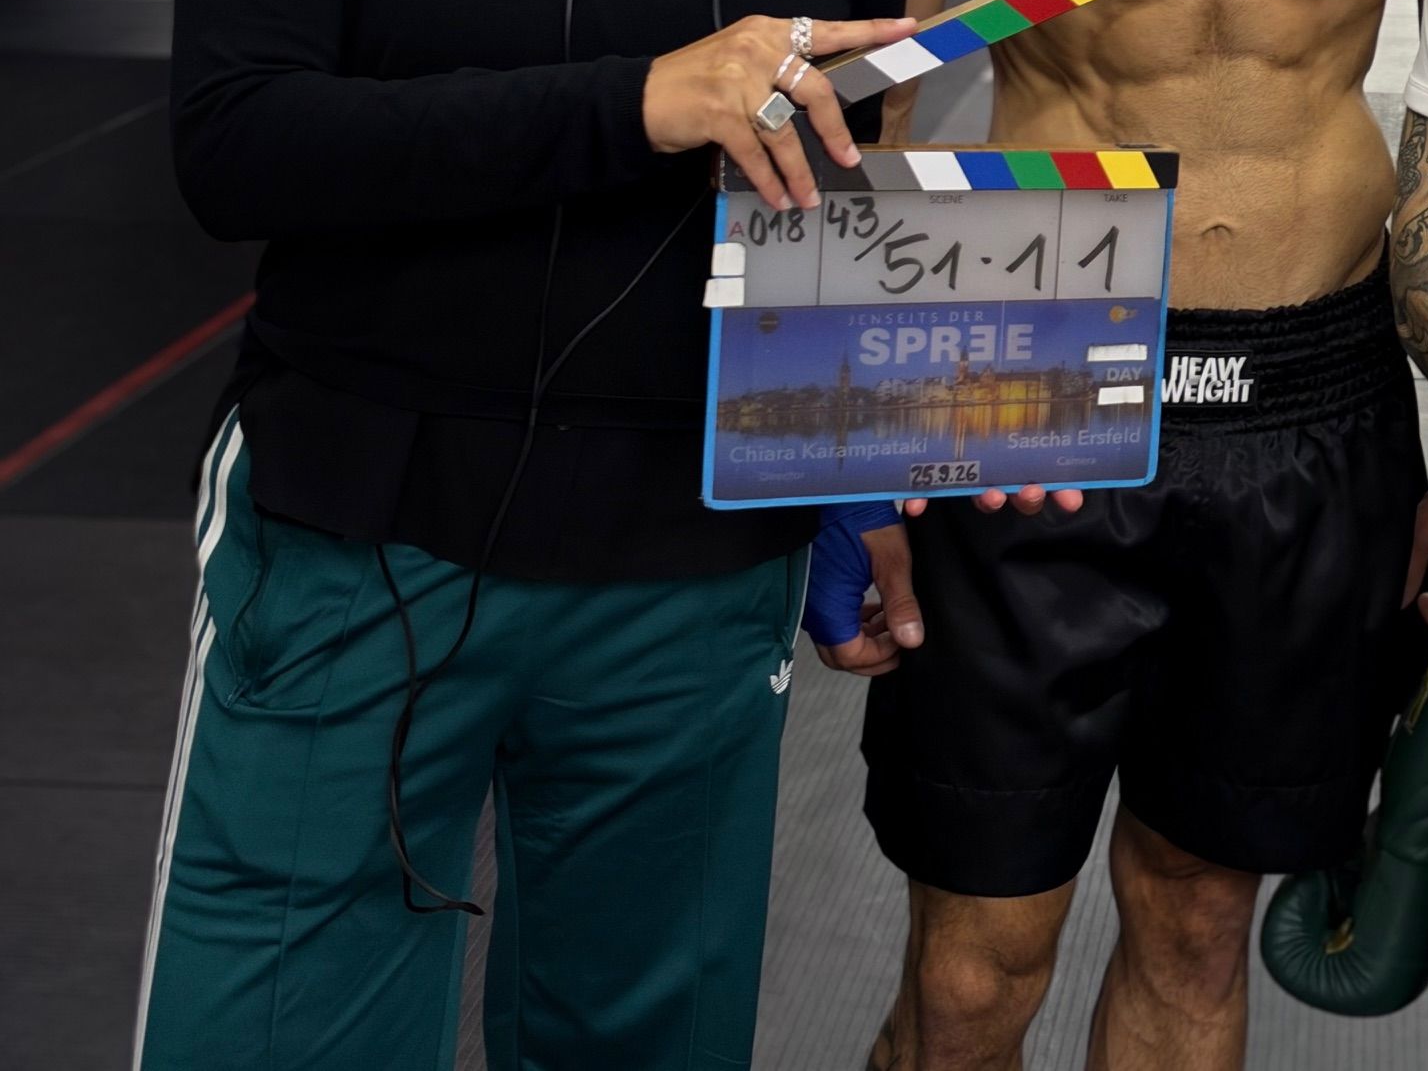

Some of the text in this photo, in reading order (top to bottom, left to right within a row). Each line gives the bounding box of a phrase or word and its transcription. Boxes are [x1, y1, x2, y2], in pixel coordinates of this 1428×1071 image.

[929, 194, 964, 204] SCENE
[1104, 193, 1128, 203] TAKE
[1078, 225, 1119, 292] 1
[848, 311, 984, 326] JENSEITS DER
[859, 324, 1034, 365] SPREE
[1106, 367, 1144, 381] DAY
[1169, 356, 1247, 383] HEAVY
[1161, 378, 1254, 403] WEIGHT
[1007, 427, 1141, 449] Sascha Ersfeld
[729, 437, 928, 464] Chiara Karampataki
